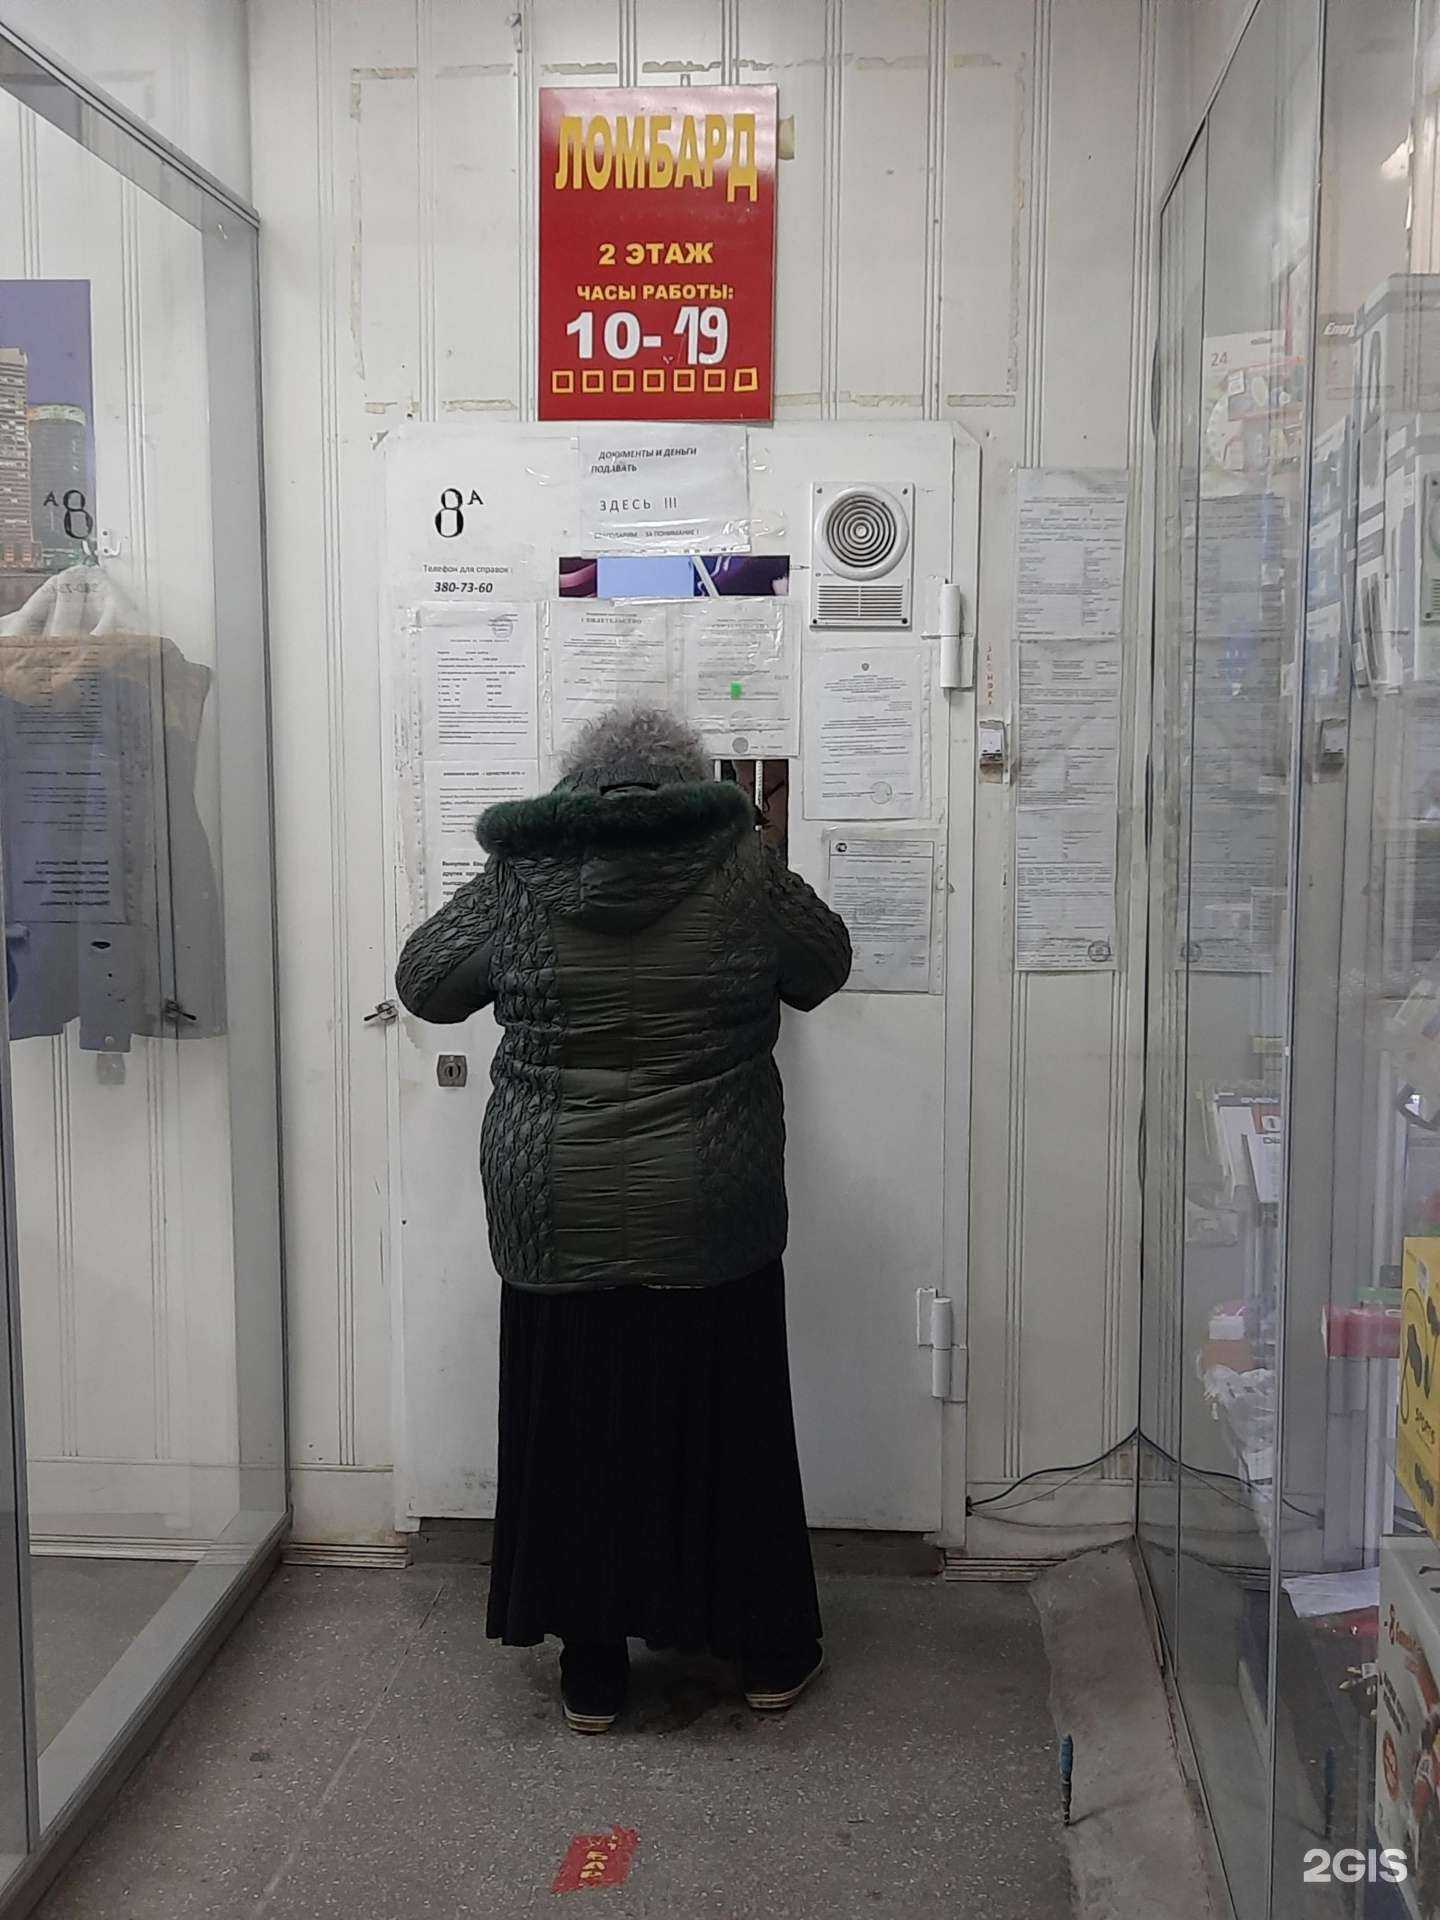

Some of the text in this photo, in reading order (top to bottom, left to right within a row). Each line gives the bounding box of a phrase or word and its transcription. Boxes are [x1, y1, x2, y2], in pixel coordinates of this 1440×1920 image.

[554, 113, 758, 202] ЛОМБАРД
[598, 242, 714, 265] 2 ЭТАЖ
[577, 284, 734, 301] ЧАСЫ РАБОТЫ:
[663, 447, 697, 457] ДЕНЬГИ
[591, 464, 638, 474] ПОДАВАТЬ
[599, 499, 651, 513] ЗДЕСЬ
[423, 564, 458, 573] Телефон
[434, 582, 493, 593] 380-73-60
